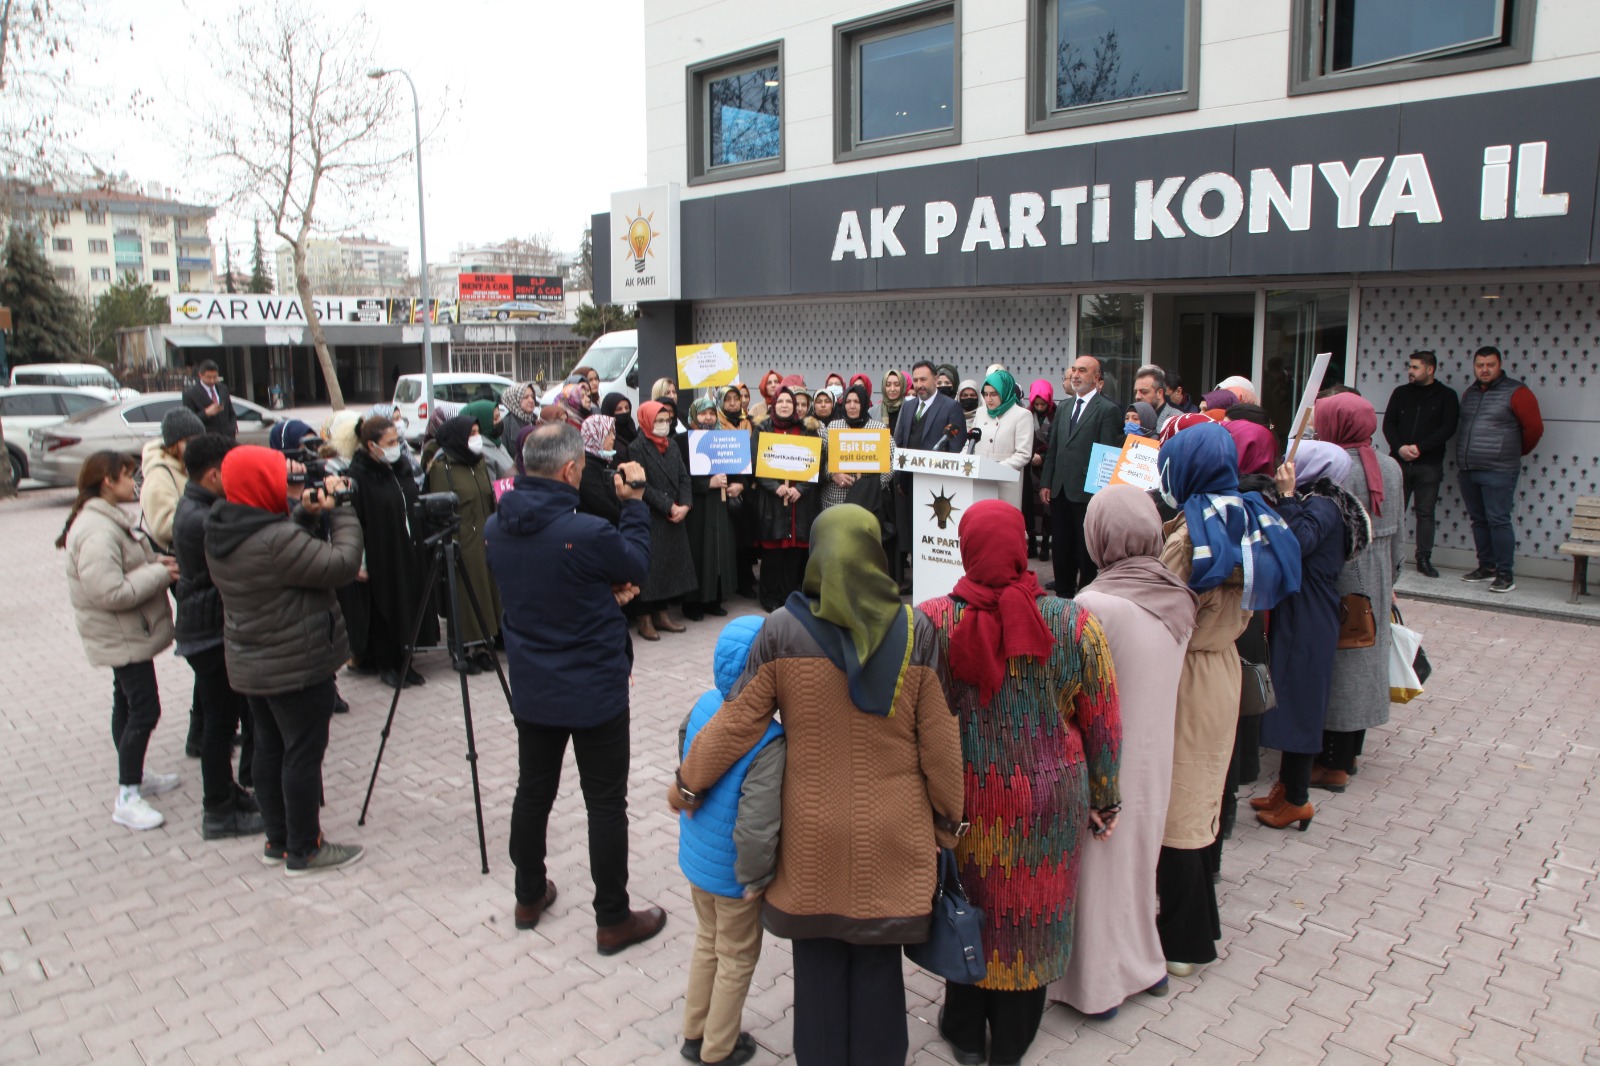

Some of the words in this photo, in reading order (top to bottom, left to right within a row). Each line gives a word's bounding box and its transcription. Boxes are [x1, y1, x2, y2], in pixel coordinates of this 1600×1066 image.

[831, 205, 907, 261] AK
[924, 183, 1111, 255] PARTİ
[1133, 153, 1443, 241] KONYA
[1479, 141, 1570, 221] İL
[625, 278, 635, 288] AK
[544, 287, 562, 295] CAR
[182, 298, 248, 320] CAR
[257, 299, 343, 320] WASH
[840, 441, 859, 453] Eşit
[861, 441, 877, 453] işe
[839, 453, 855, 461] eşit
[856, 453, 879, 461] ücret.
[911, 456, 926, 467] AK
[921, 535, 935, 545] AK
[937, 536, 960, 549] PART
[931, 548, 952, 556] KONYA
